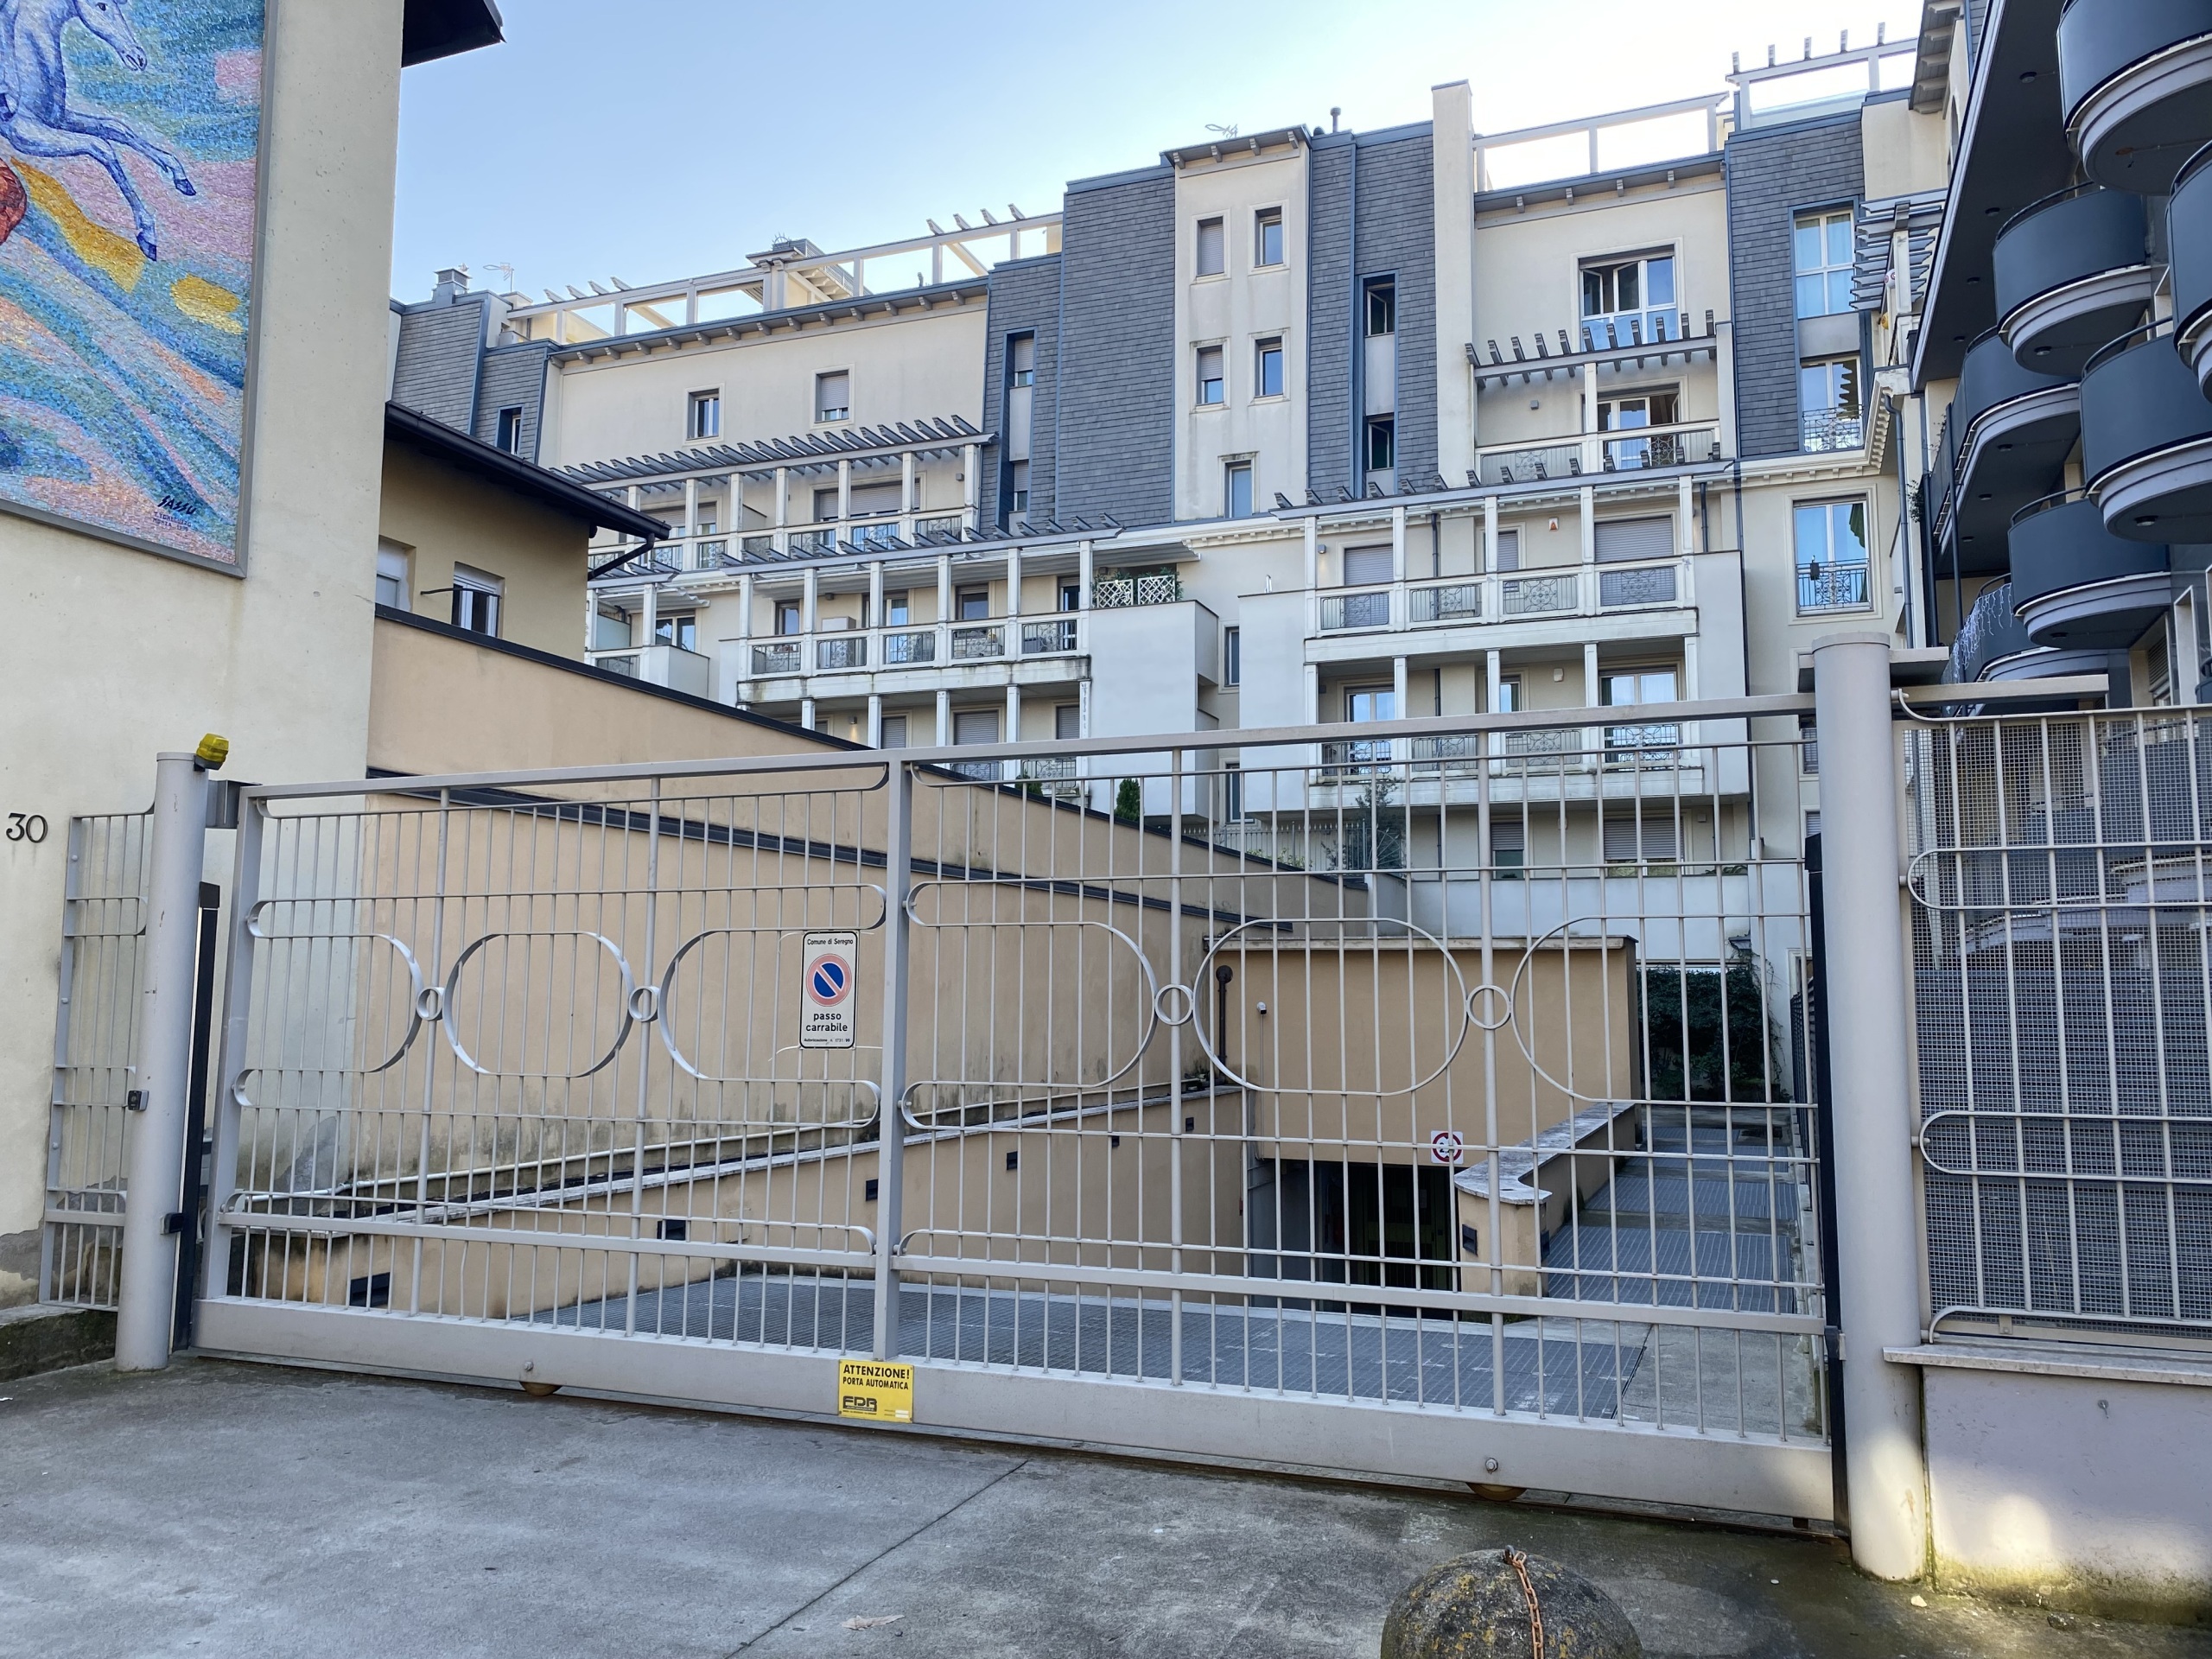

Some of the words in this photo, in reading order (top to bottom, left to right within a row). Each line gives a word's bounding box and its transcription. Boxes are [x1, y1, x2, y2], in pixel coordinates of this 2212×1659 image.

[157, 495, 197, 514] SASSU
[6, 812, 48, 843] 30
[813, 1013, 842, 1021] passo
[805, 1022, 848, 1032] carrabile
[843, 1364, 910, 1380] ATTENZIONE!
[842, 1376, 864, 1386] PORTA
[866, 1378, 909, 1389] AUTOMATICA
